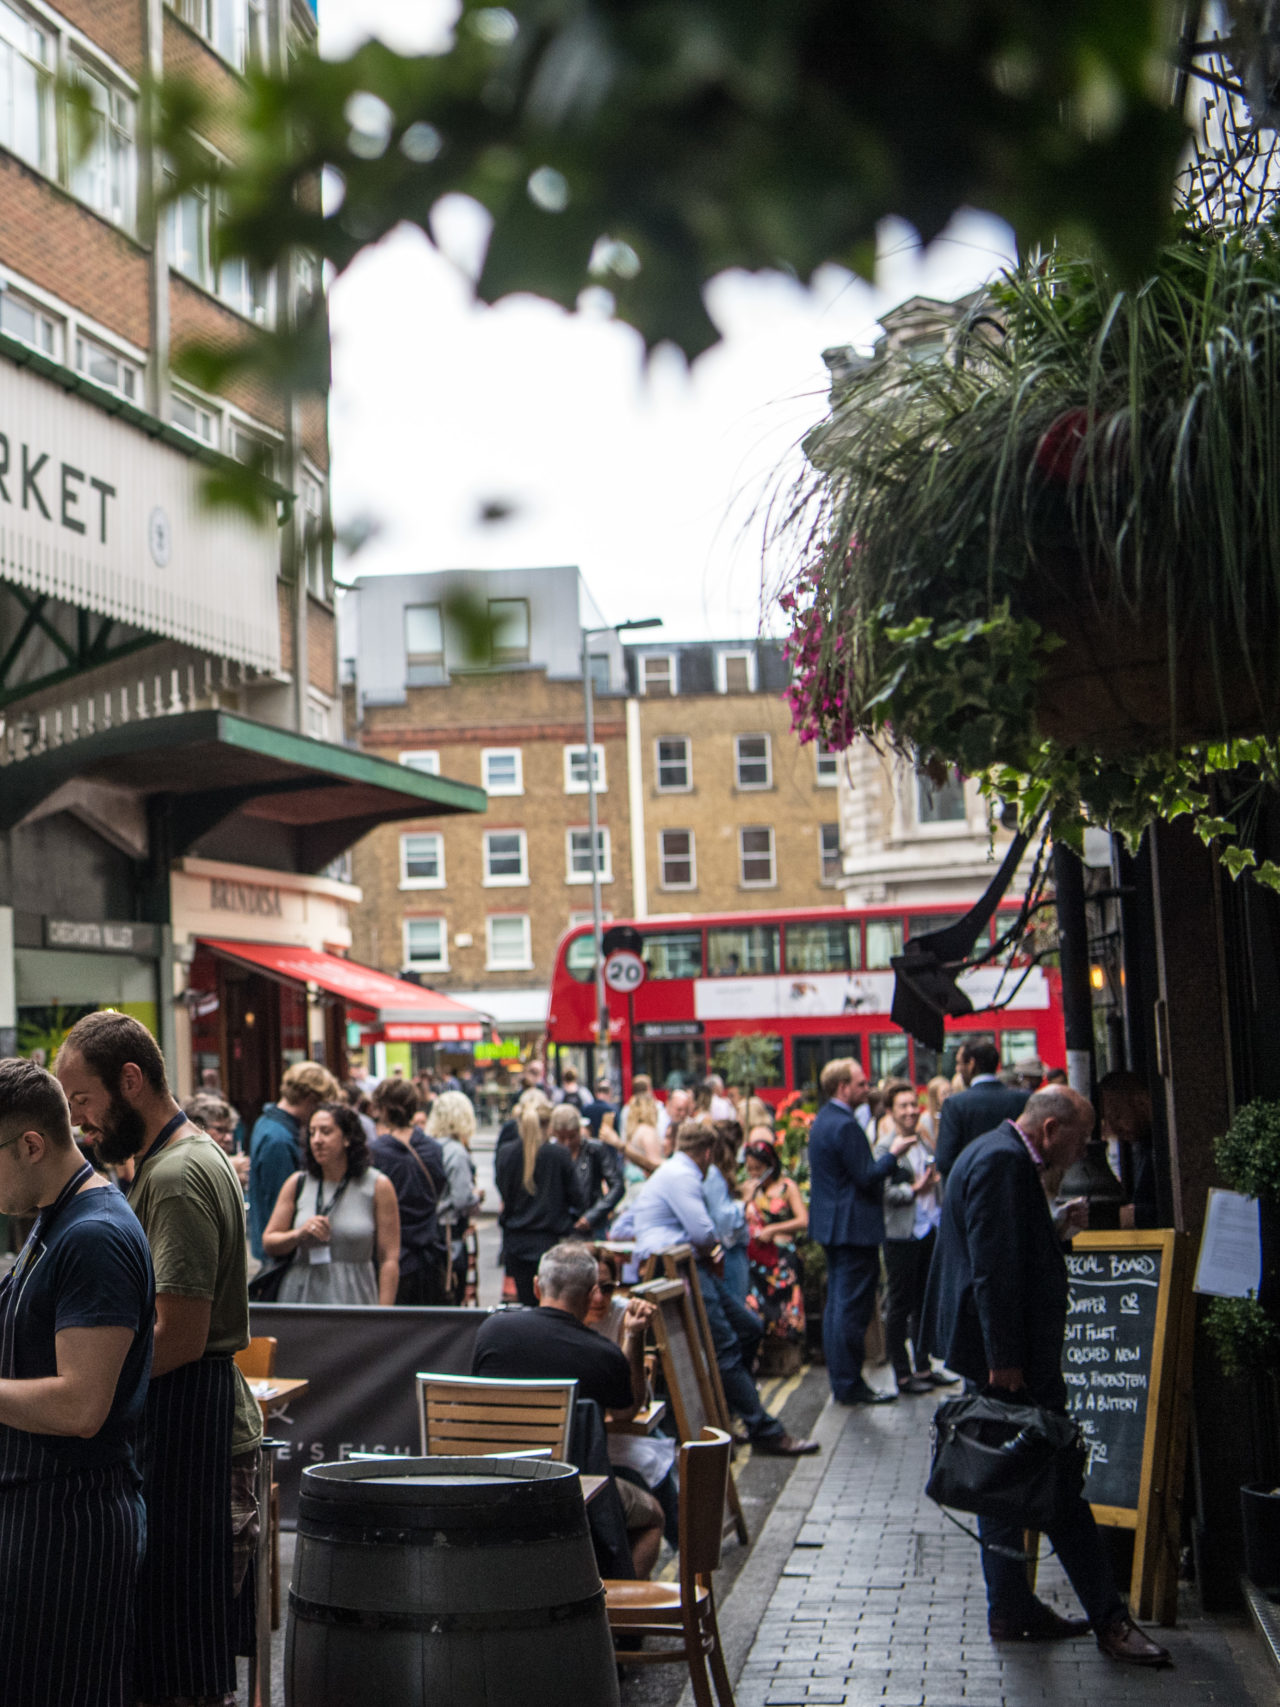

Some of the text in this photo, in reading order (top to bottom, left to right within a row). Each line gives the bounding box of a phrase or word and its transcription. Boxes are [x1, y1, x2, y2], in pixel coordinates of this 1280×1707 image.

[210, 879, 283, 917] BRINDISA
[609, 962, 640, 983] 20
[1064, 1254, 1156, 1277] PECIAL BOARD
[1120, 1292, 1139, 1311] OR
[1064, 1323, 1083, 1340] BUT
[1115, 1345, 1141, 1362] NEW
[1062, 1372, 1089, 1390] TOES,
[1086, 1392, 1095, 1410] A
[276, 1440, 326, 1461] E'S
